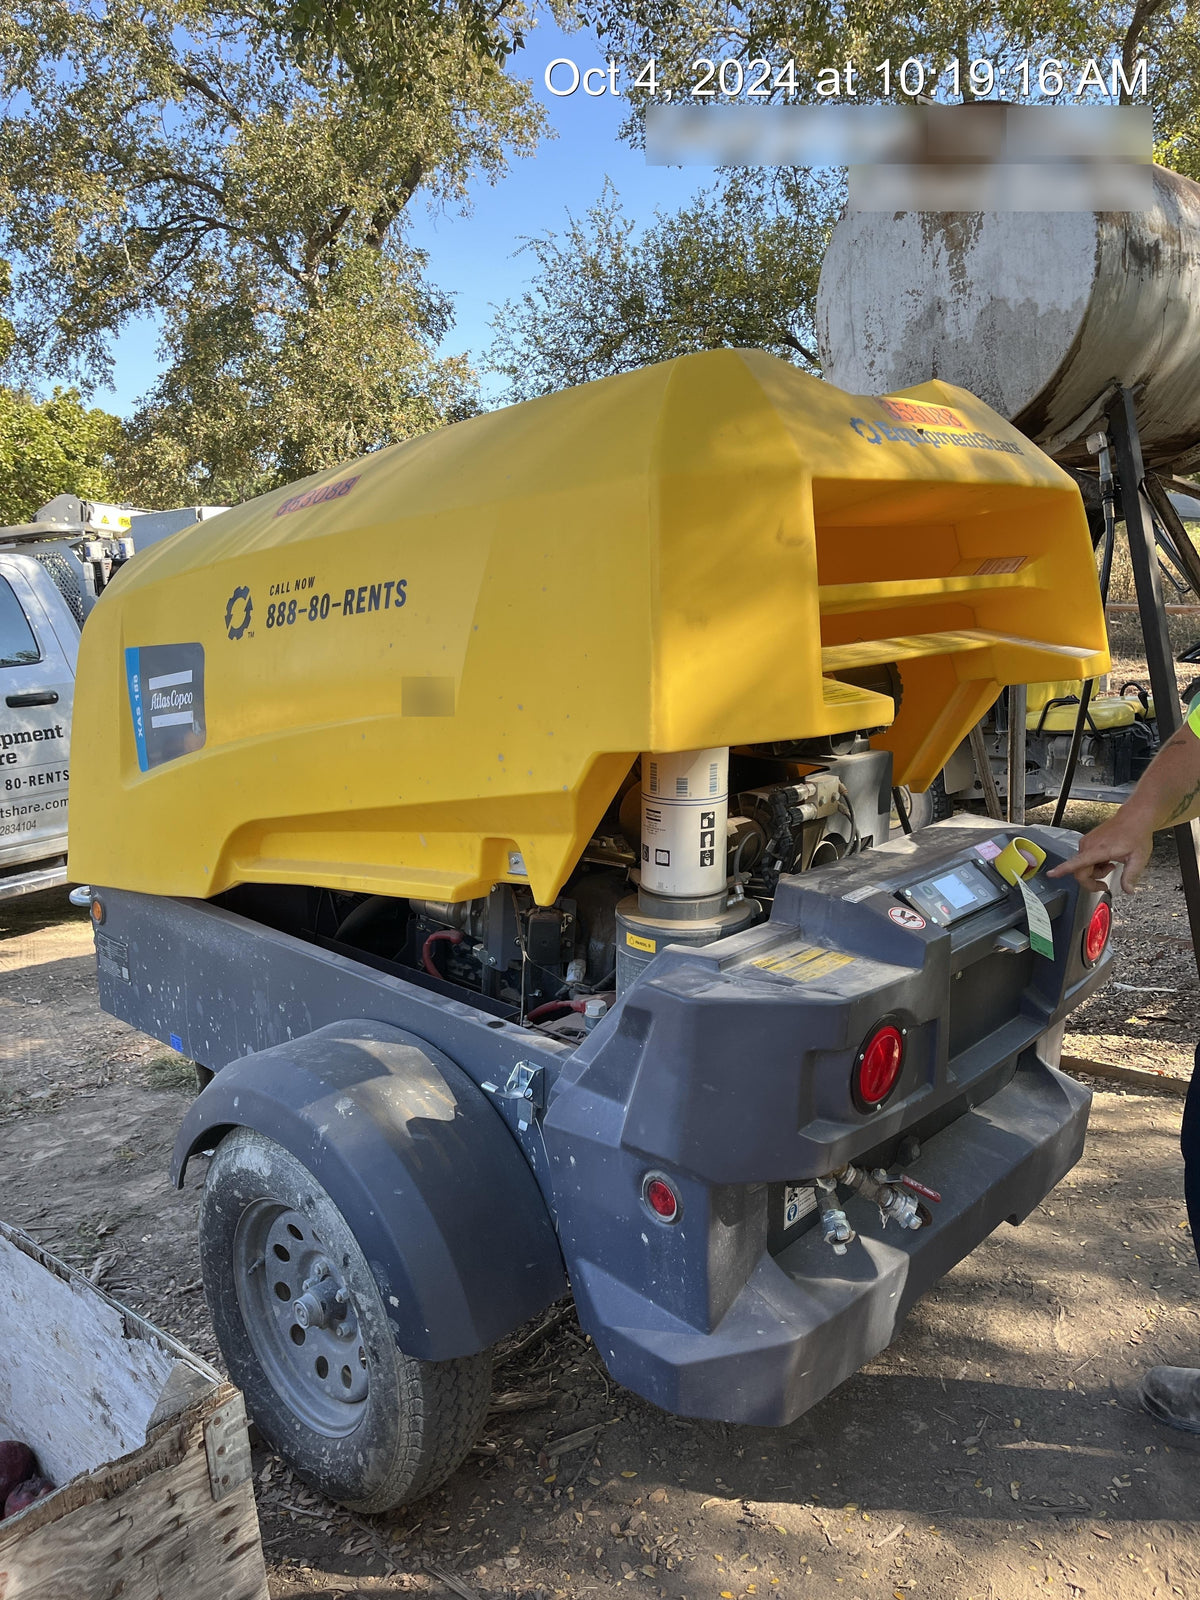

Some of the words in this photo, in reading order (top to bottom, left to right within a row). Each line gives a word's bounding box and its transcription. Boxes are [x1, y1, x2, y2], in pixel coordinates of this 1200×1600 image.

[269, 581, 291, 597] CALL
[294, 576, 316, 592] NOW
[265, 578, 408, 629] 888-80-RENTS
[150, 692, 171, 711] Atlas
[170, 690, 193, 709] Copco
[136, 706, 144, 737] XAS
[0, 724, 64, 750] pment
[5, 769, 70, 791] 80-RENTS
